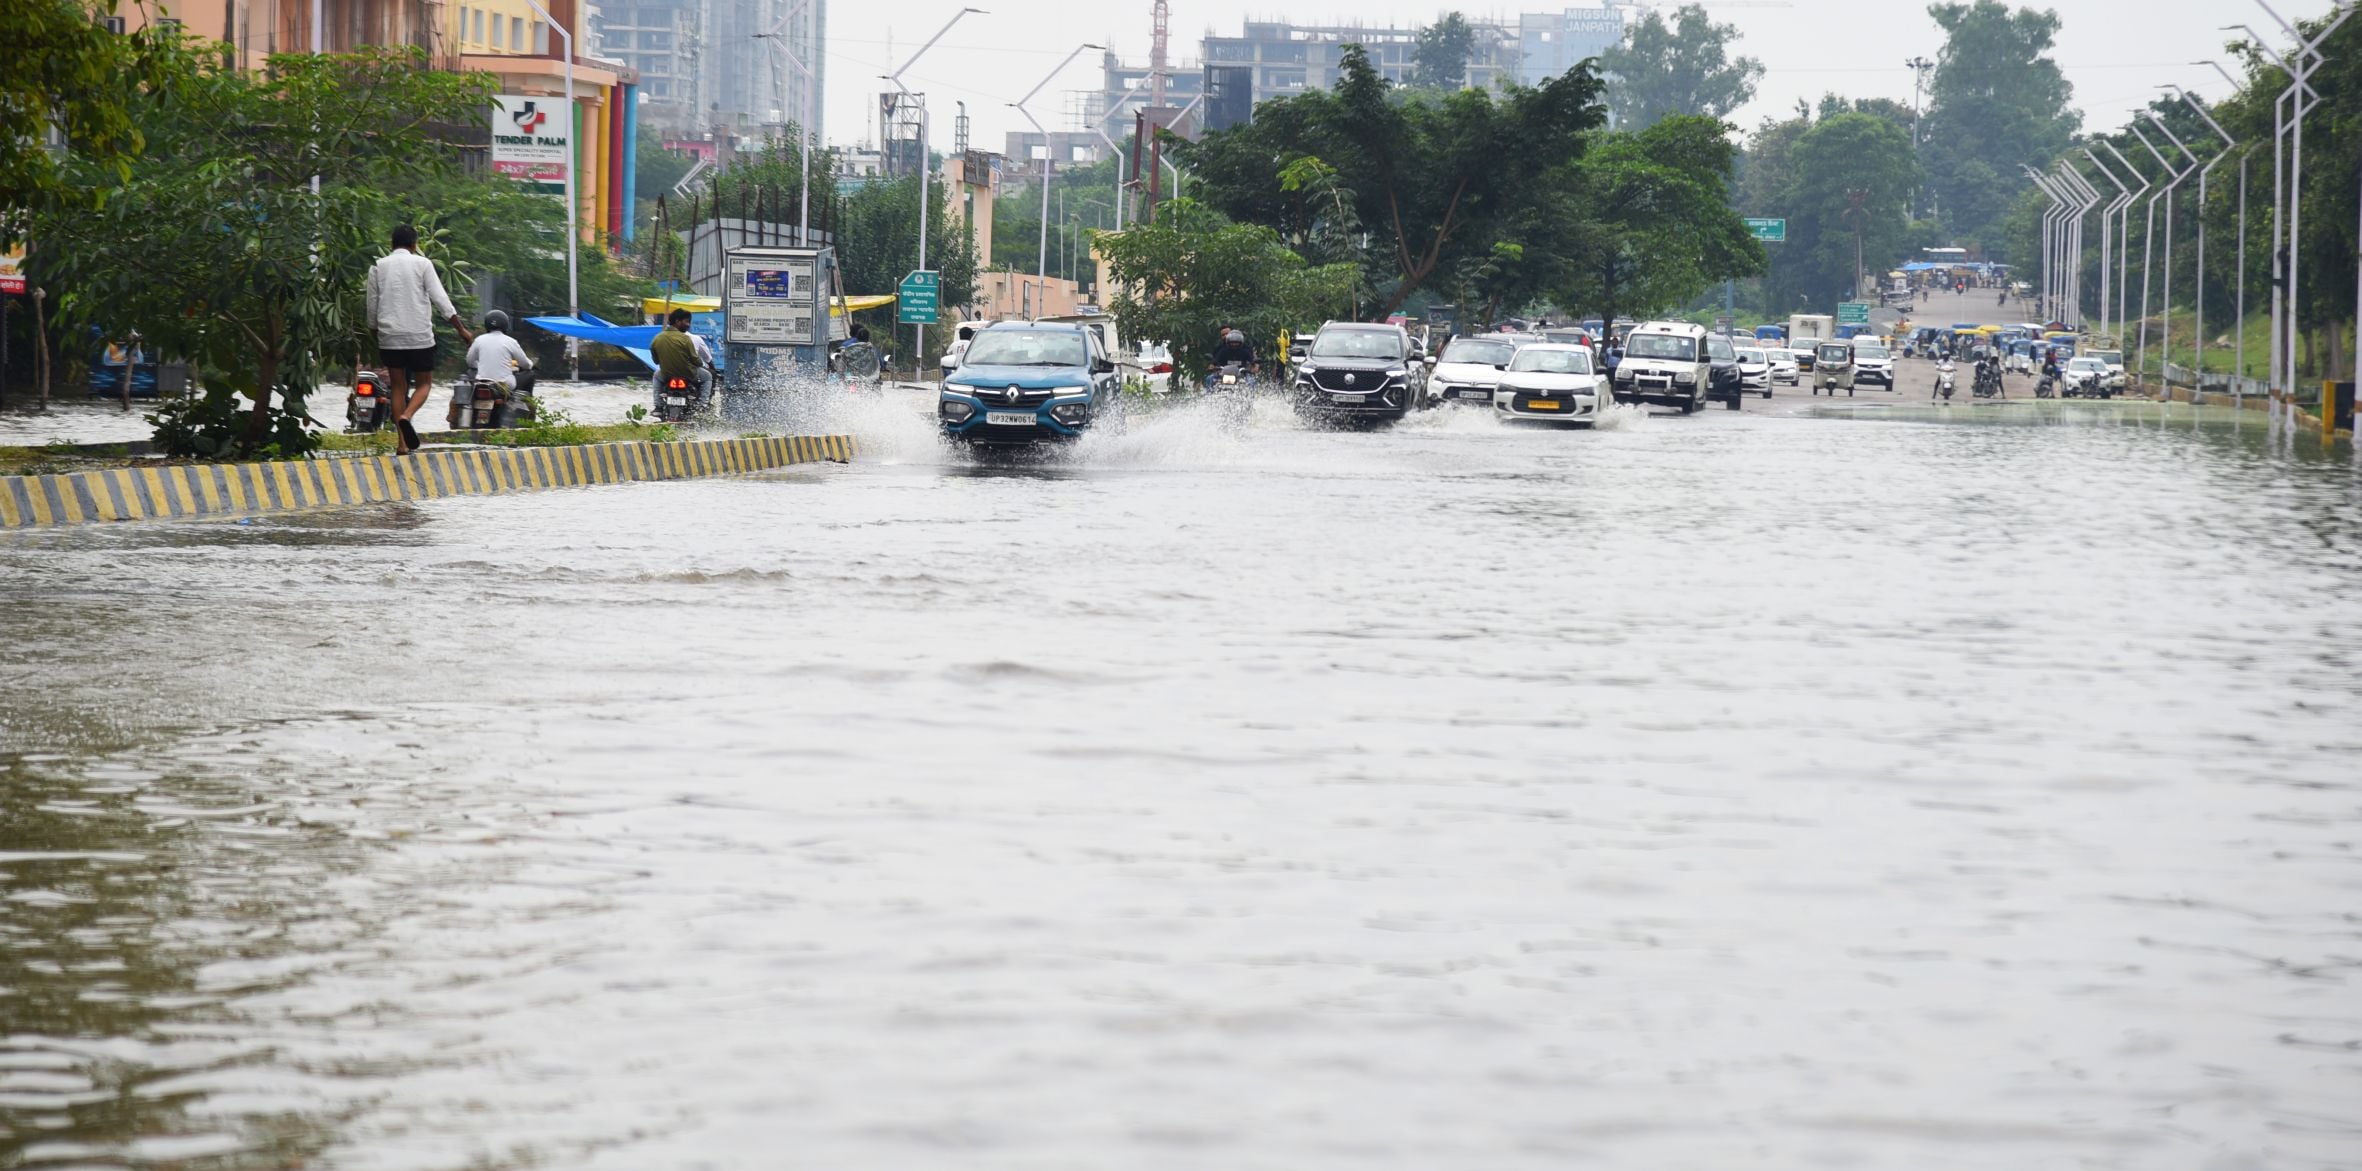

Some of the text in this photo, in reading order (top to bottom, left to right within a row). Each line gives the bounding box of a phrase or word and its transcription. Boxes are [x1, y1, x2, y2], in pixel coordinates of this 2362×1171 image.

[1566, 9, 1620, 20] MIGSUN
[1565, 21, 1620, 33] JANPATH
[494, 135, 567, 146] TENDER PALM
